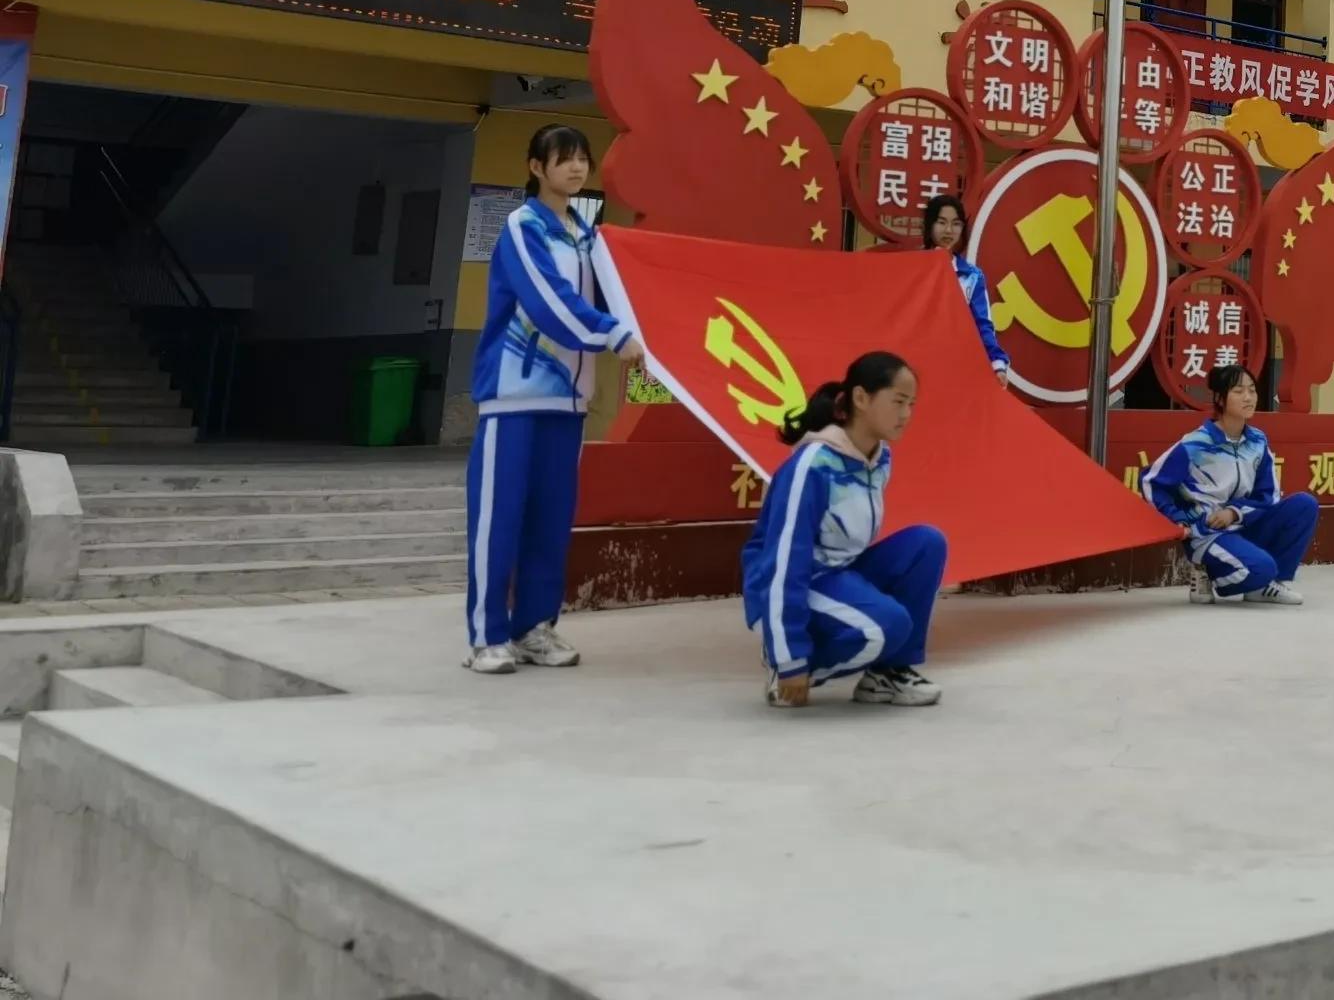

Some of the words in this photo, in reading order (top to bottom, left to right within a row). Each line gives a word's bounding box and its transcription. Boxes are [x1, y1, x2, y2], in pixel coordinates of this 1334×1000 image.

[984, 30, 1049, 72] 文明
[983, 77, 1050, 119] 和谐
[880, 120, 952, 162] 富强
[877, 169, 949, 208] 民主
[1180, 161, 1237, 194] 公正
[1176, 202, 1235, 238] 法治
[1183, 300, 1242, 335] 诚信
